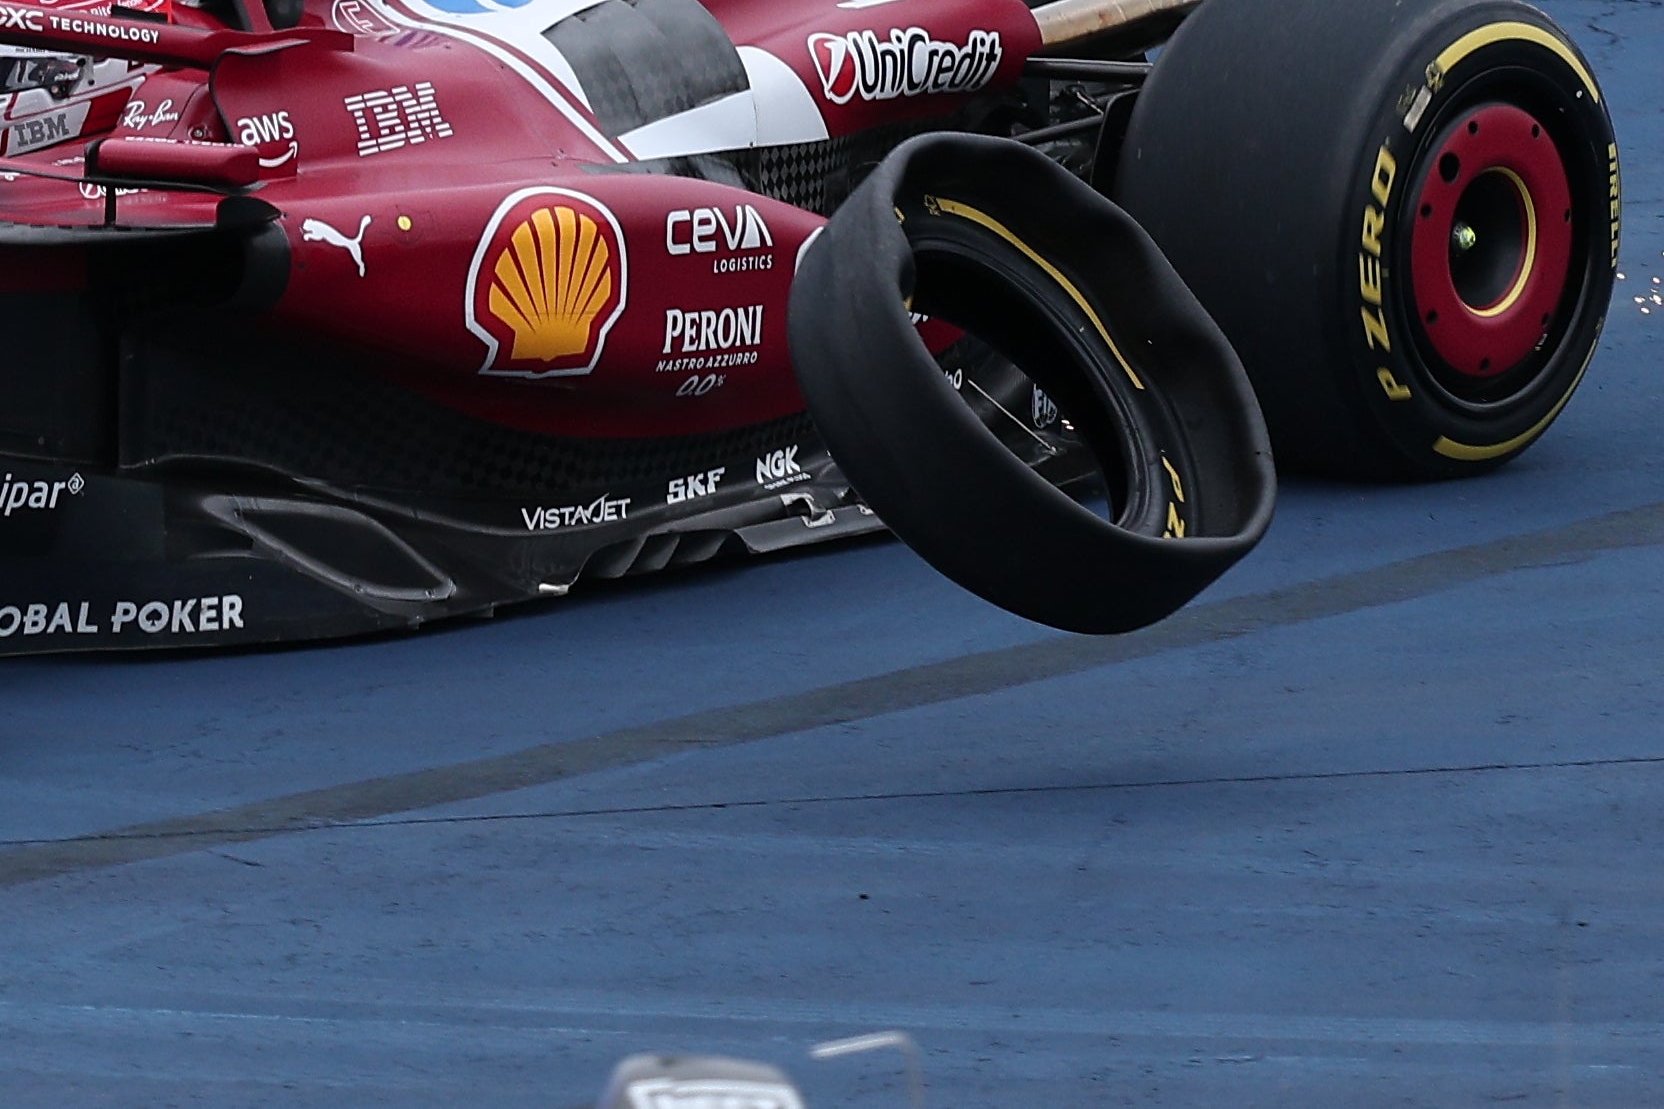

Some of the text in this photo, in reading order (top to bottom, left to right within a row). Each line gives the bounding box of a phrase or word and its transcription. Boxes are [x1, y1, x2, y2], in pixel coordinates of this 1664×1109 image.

[49, 16, 159, 44] TECHNOLOGY
[854, 28, 1003, 100] UniCredit
[14, 114, 70, 147] IBM
[237, 110, 294, 146] aws
[344, 81, 453, 157] IBM
[666, 204, 774, 255] CEVA
[713, 254, 773, 274] LOGISTICS
[1358, 144, 1412, 401] P ZERO
[663, 304, 764, 354] PERONI
[656, 351, 758, 372] NASTRO AZZURRO
[756, 444, 801, 484] NGK
[666, 466, 725, 505] SKF
[110, 595, 245, 635] POKER
